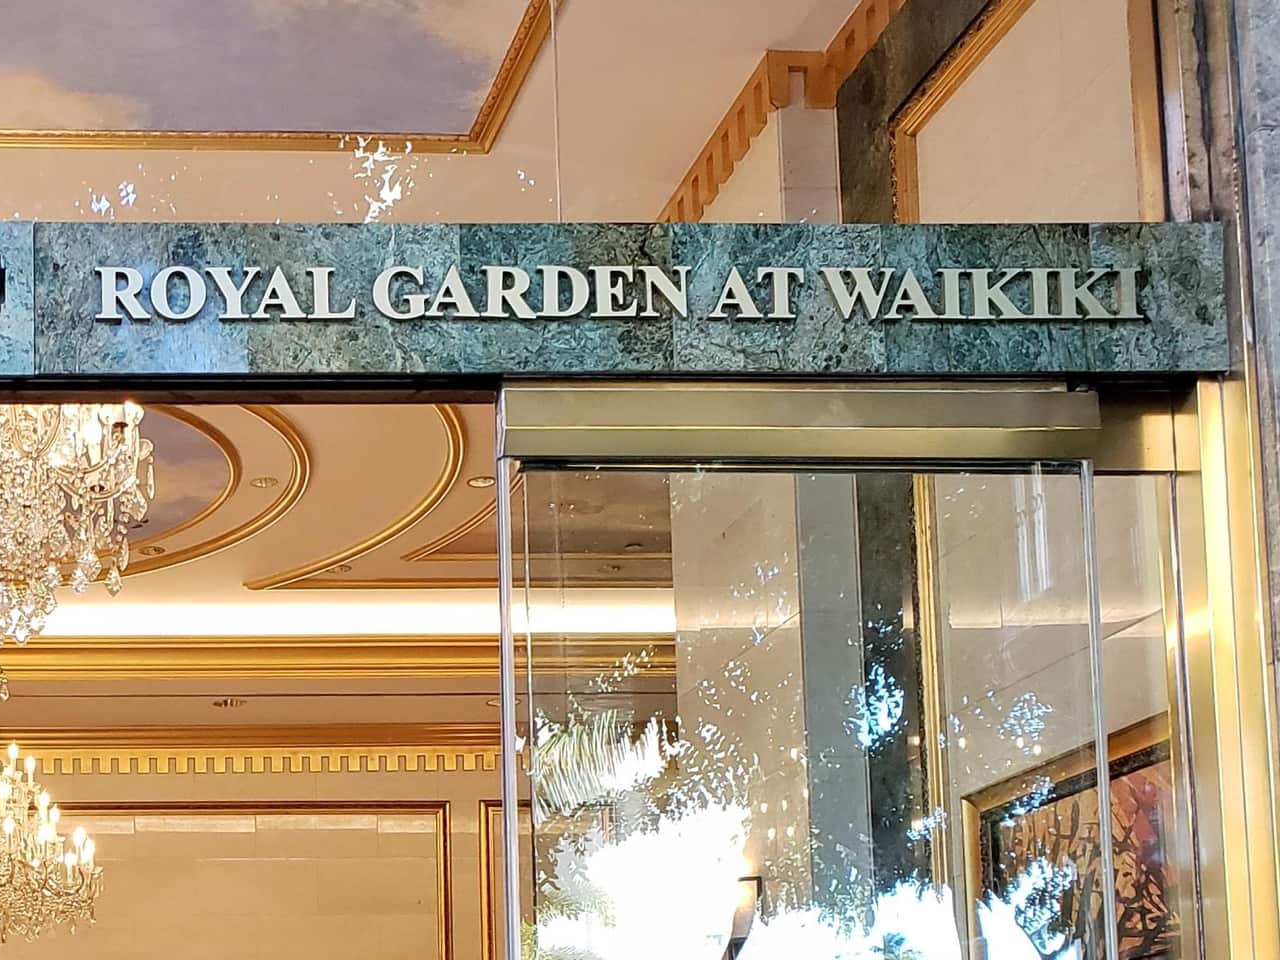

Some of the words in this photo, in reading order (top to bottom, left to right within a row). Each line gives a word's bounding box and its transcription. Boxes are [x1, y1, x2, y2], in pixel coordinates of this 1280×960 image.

[95, 265, 356, 320] ROYAL
[371, 265, 693, 320] GARDEN
[708, 266, 805, 320] AT
[819, 266, 1146, 320] WAIKIKI
